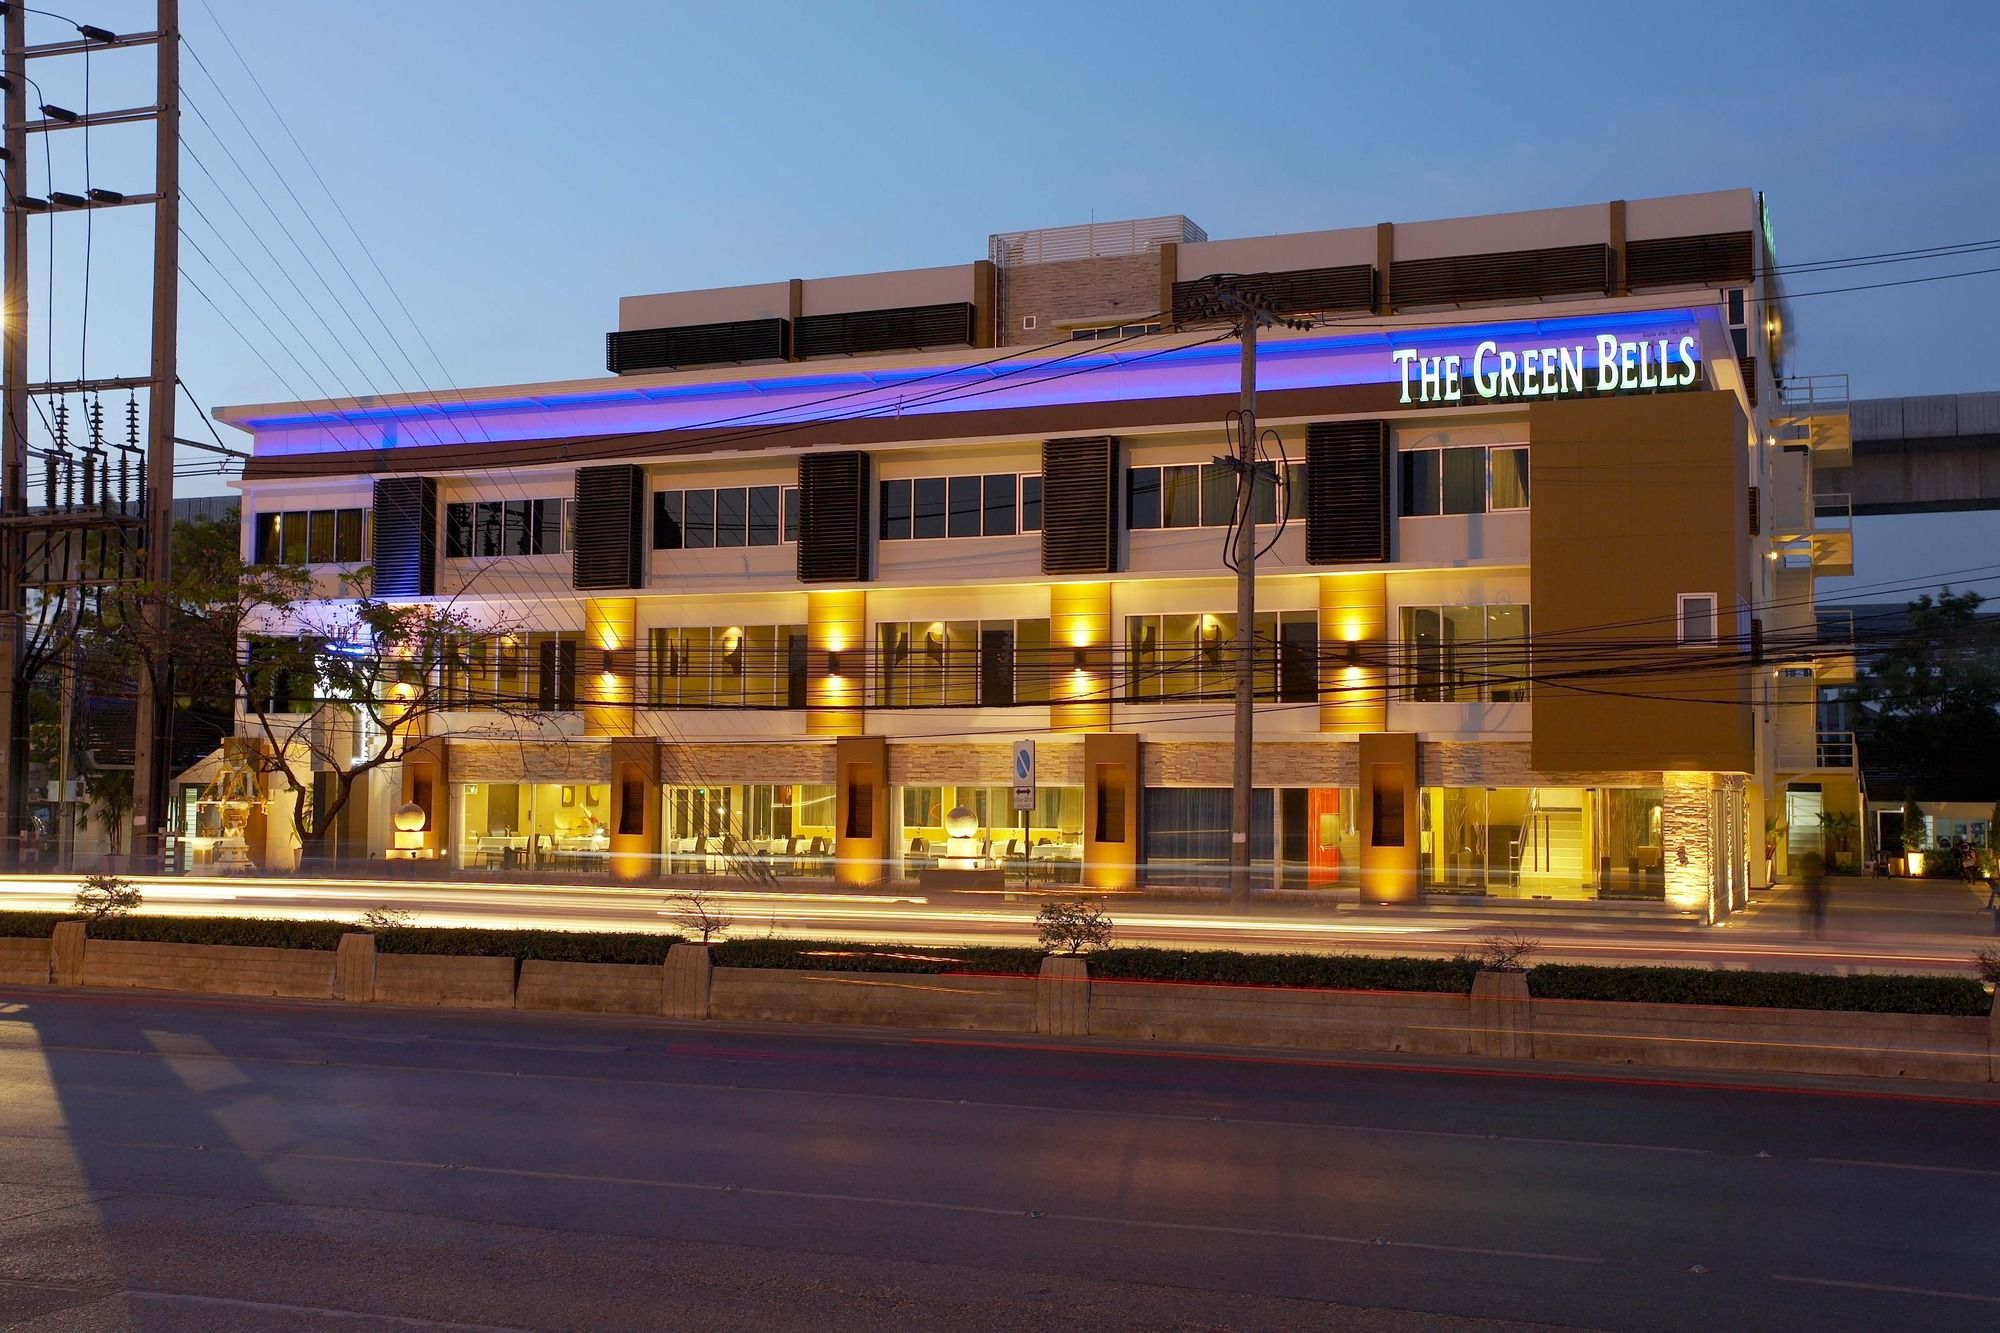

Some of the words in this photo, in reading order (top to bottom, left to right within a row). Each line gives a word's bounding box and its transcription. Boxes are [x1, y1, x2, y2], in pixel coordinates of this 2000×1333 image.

[1393, 349, 1461, 403] THE
[1473, 341, 1583, 398] GREEN
[1597, 334, 1696, 391] BELLS
